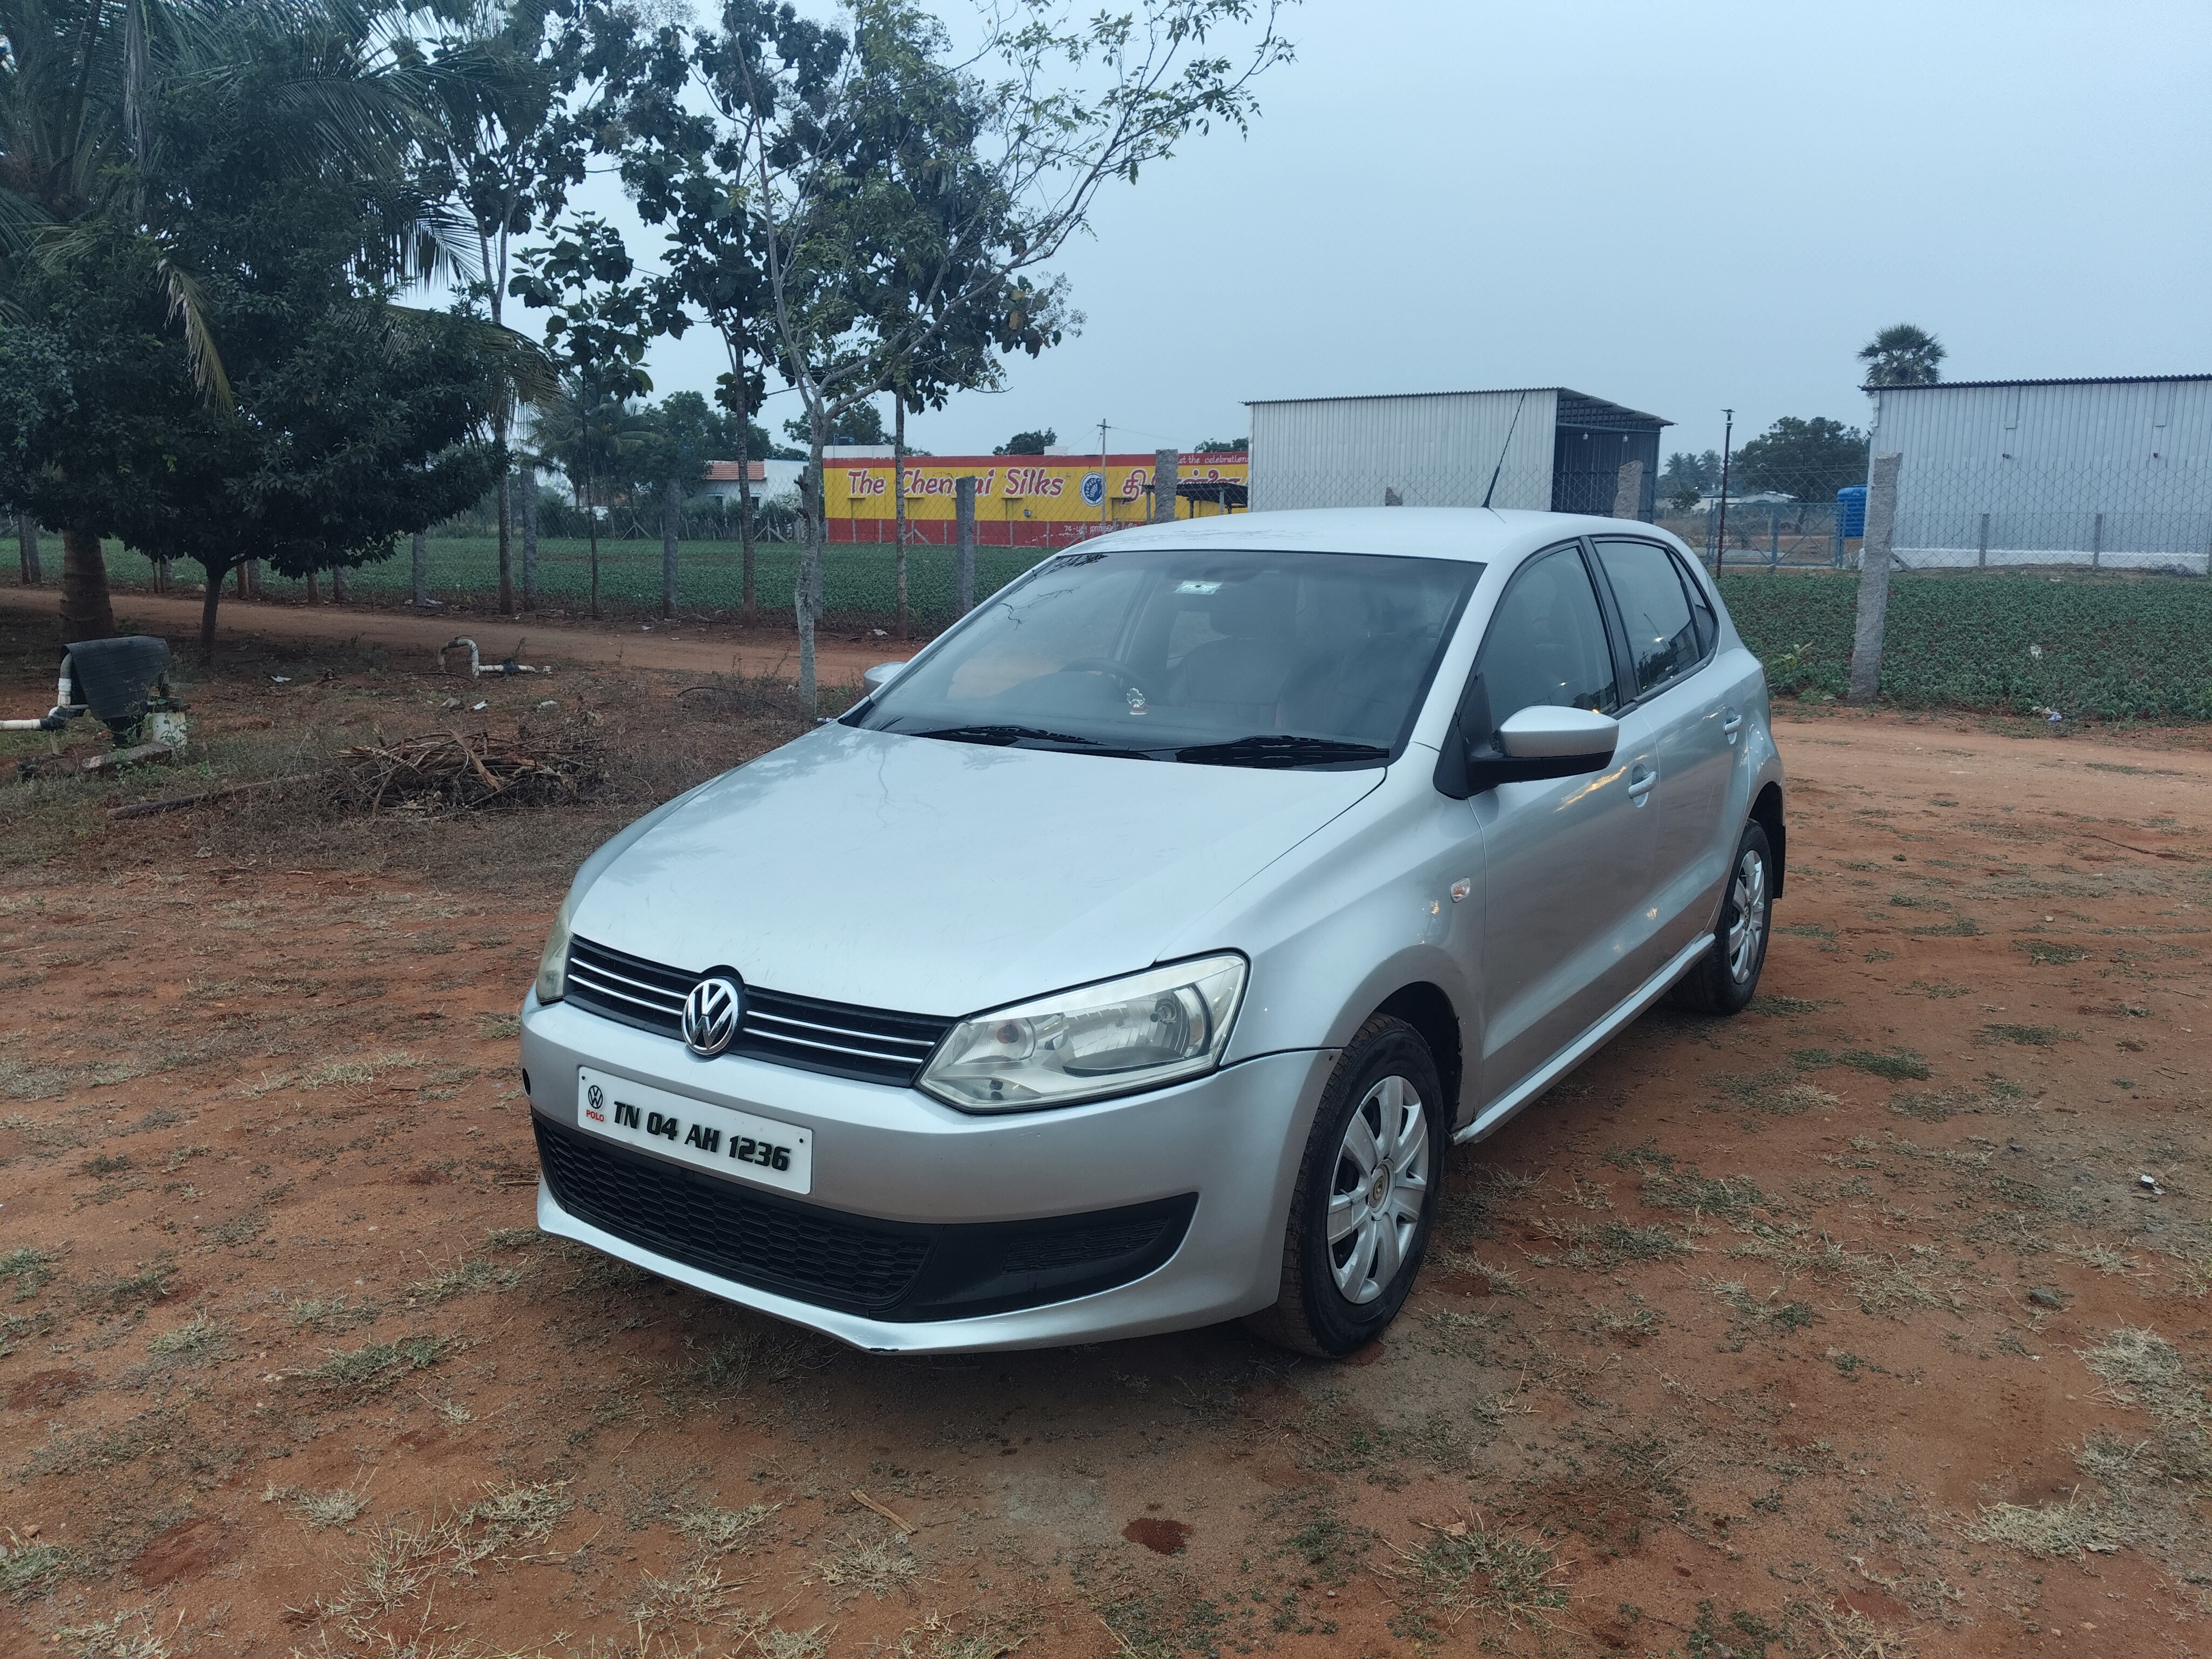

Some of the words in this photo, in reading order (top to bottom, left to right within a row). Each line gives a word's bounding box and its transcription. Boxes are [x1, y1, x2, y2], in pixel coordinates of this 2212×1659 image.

[1177, 455, 1187, 464] et
[1189, 455, 1200, 463] the
[847, 468, 886, 496] The
[903, 468, 996, 497] Chenai
[1004, 467, 1065, 497] Silks
[586, 1109, 604, 1122] POLO
[613, 1101, 641, 1129] TN
[646, 1111, 678, 1141] 04
[684, 1123, 721, 1153] AH
[729, 1135, 791, 1171] 1236
